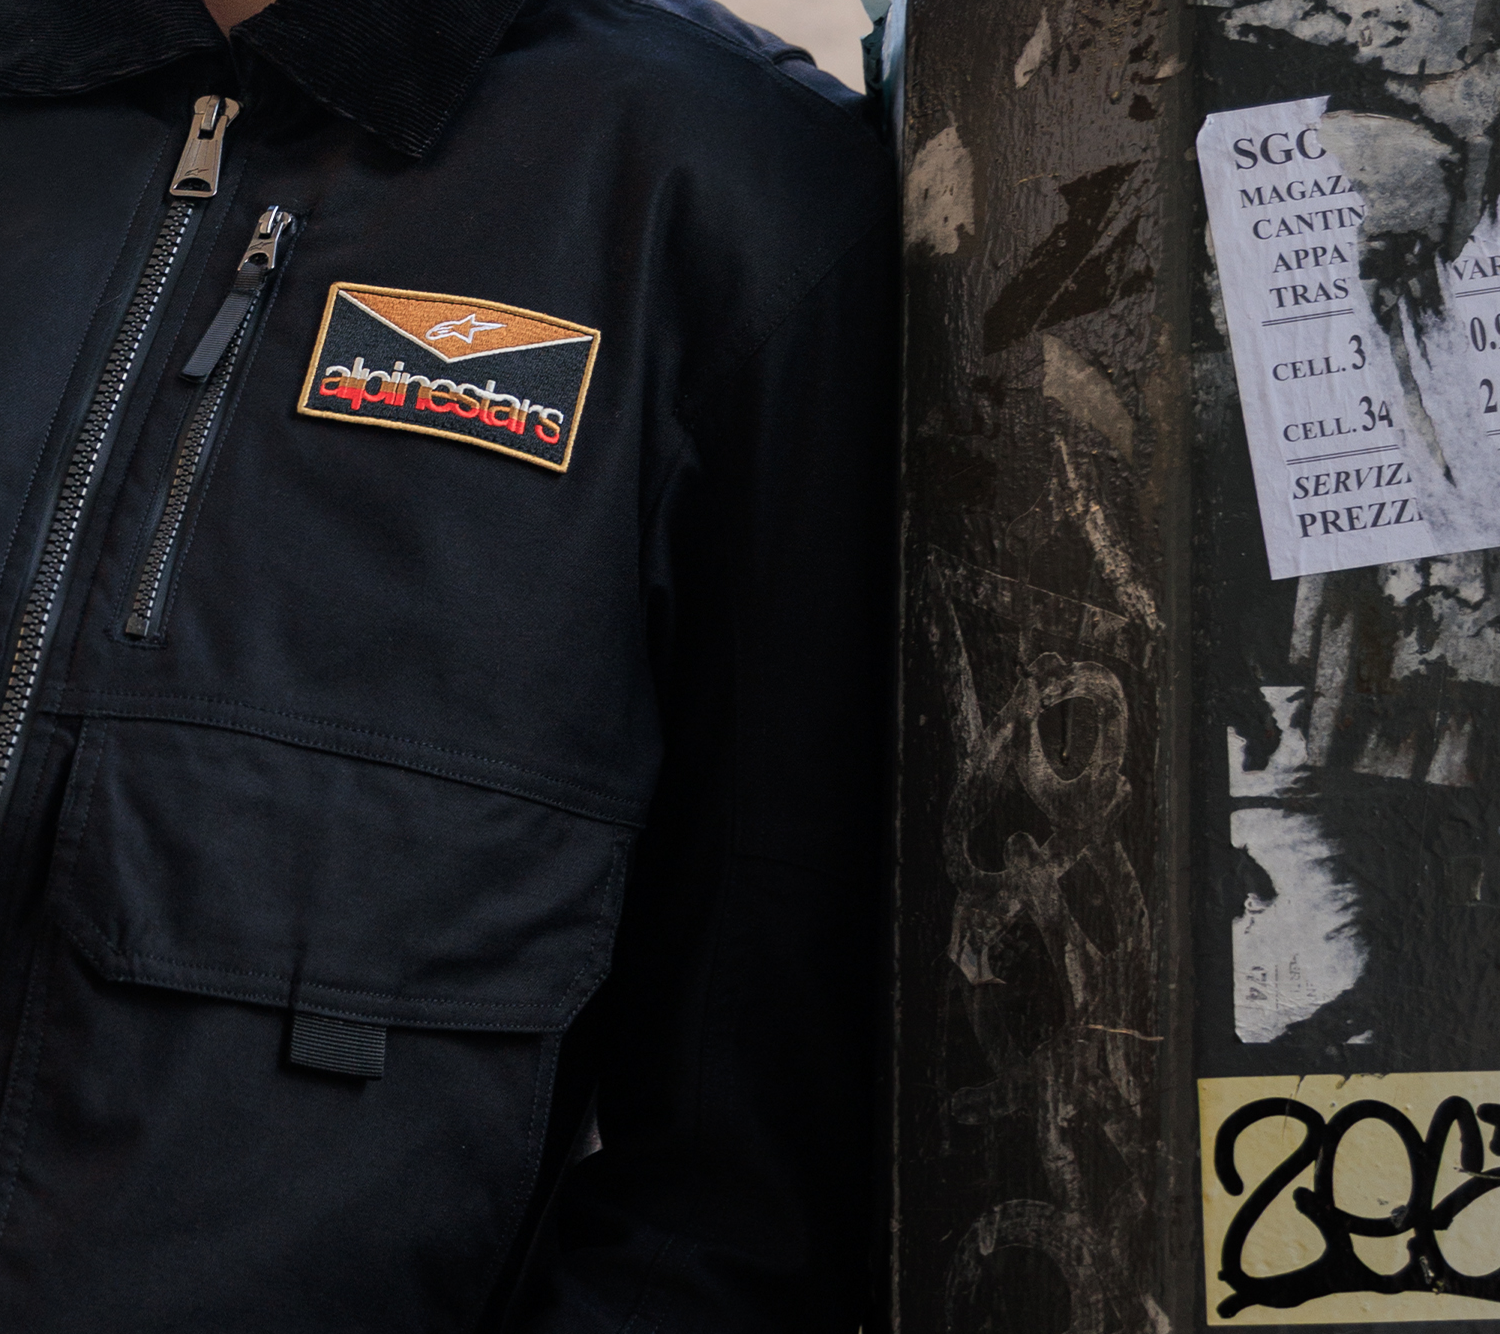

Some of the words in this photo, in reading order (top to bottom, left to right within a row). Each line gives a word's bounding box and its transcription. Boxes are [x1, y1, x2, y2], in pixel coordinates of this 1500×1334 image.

[1238, 174, 1355, 209] MAGAZ
[1272, 242, 1354, 274] APPA
[1269, 278, 1350, 309] TRAS
[319, 356, 564, 444] alpinestars
